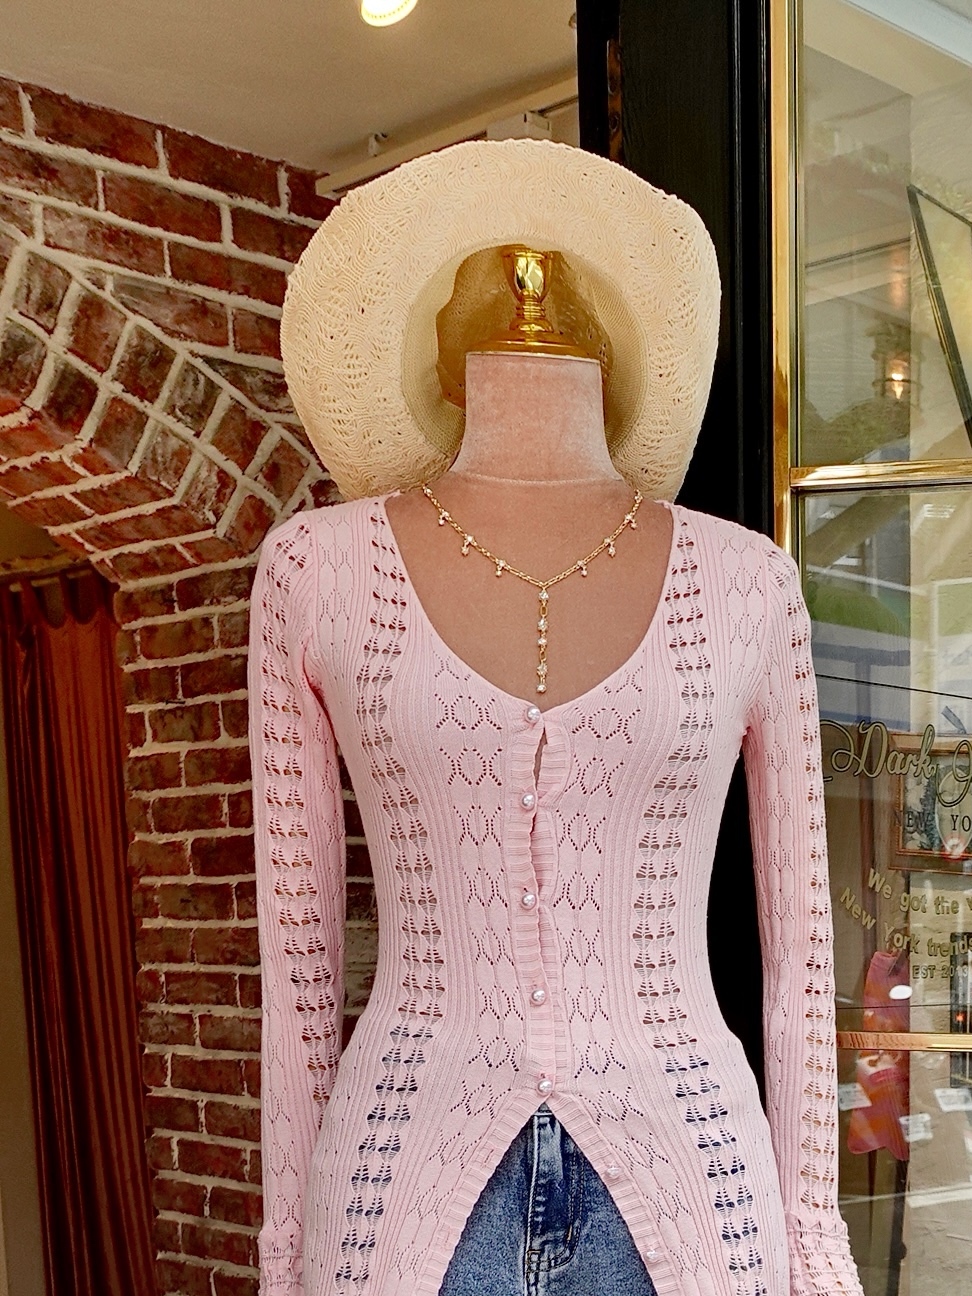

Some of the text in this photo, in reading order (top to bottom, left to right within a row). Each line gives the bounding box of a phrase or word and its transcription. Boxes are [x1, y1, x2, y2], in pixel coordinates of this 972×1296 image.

[867, 867, 893, 899] We
[899, 893, 928, 914] got
[933, 895, 960, 916] the
[839, 886, 877, 931] New
[883, 921, 920, 955] York
[911, 965, 936, 980] EST
